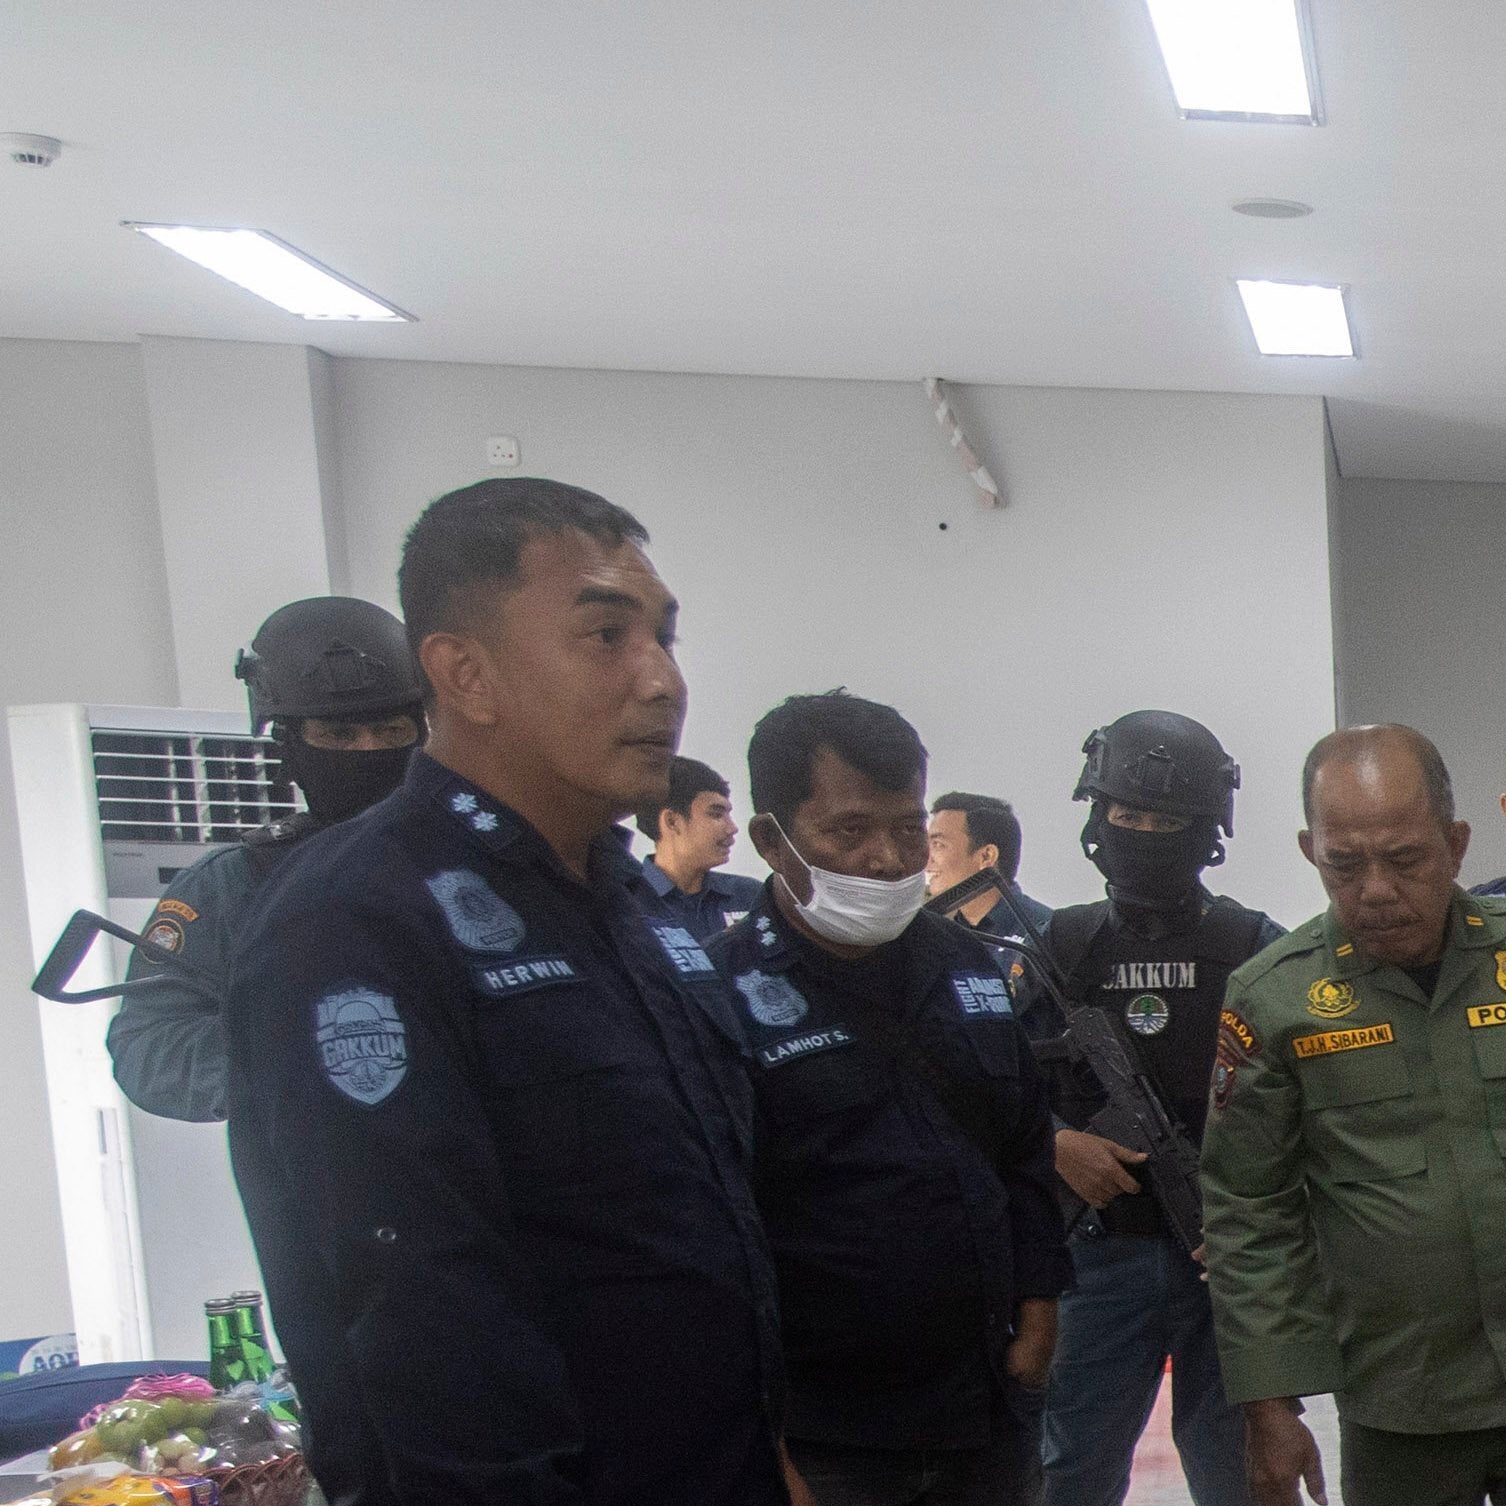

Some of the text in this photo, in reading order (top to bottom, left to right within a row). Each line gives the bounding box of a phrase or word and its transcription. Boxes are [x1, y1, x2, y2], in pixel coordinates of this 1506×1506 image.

[484, 960, 576, 989] HERWIN
[764, 1030, 849, 1062] LAMHOT S.
